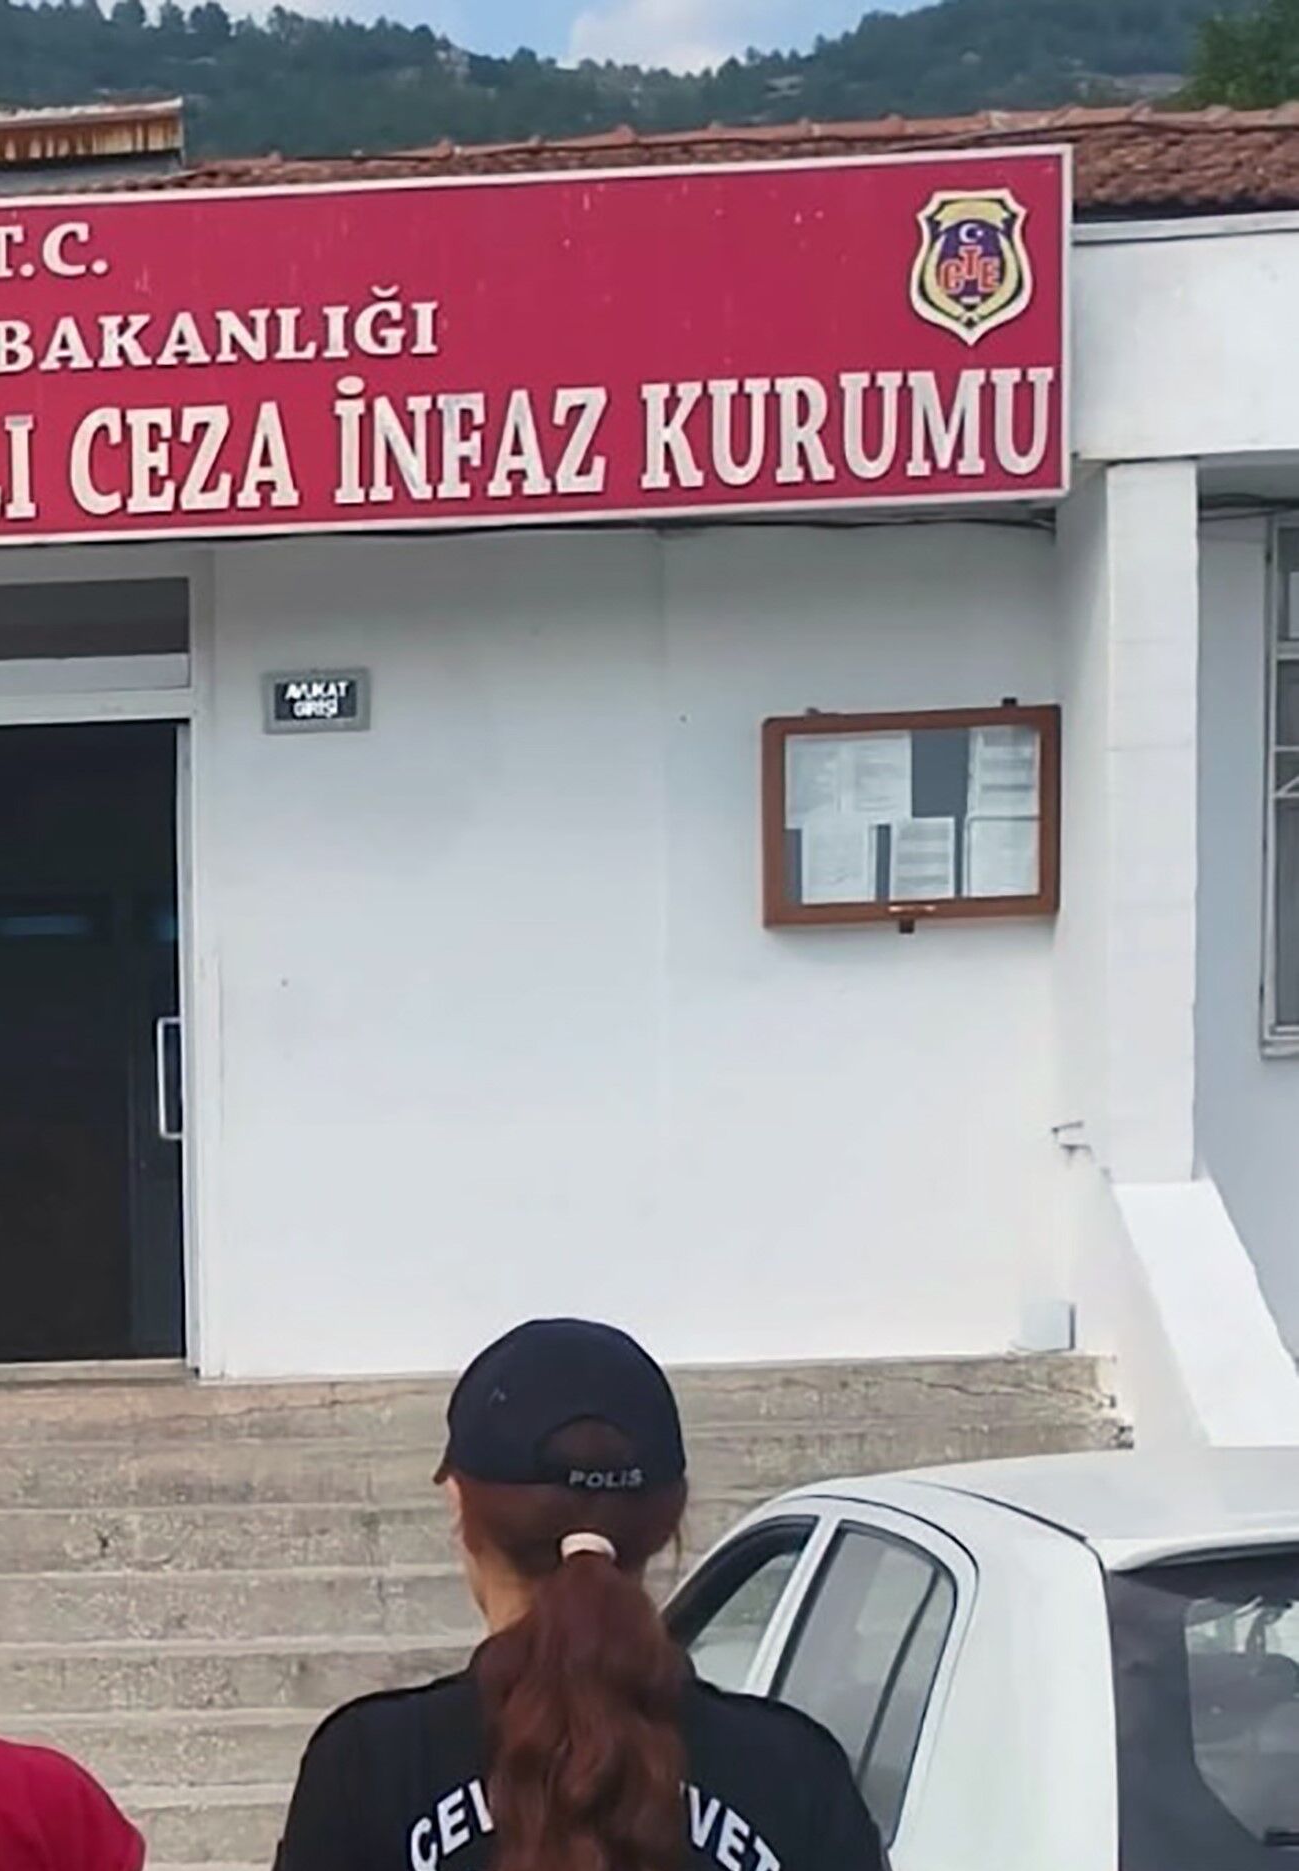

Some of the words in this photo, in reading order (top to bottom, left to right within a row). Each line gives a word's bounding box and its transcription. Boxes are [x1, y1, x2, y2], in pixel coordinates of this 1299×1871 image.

[69, 400, 300, 515] CEZA
[333, 375, 608, 505] İNFAZ
[640, 366, 1054, 491] KURUMU
